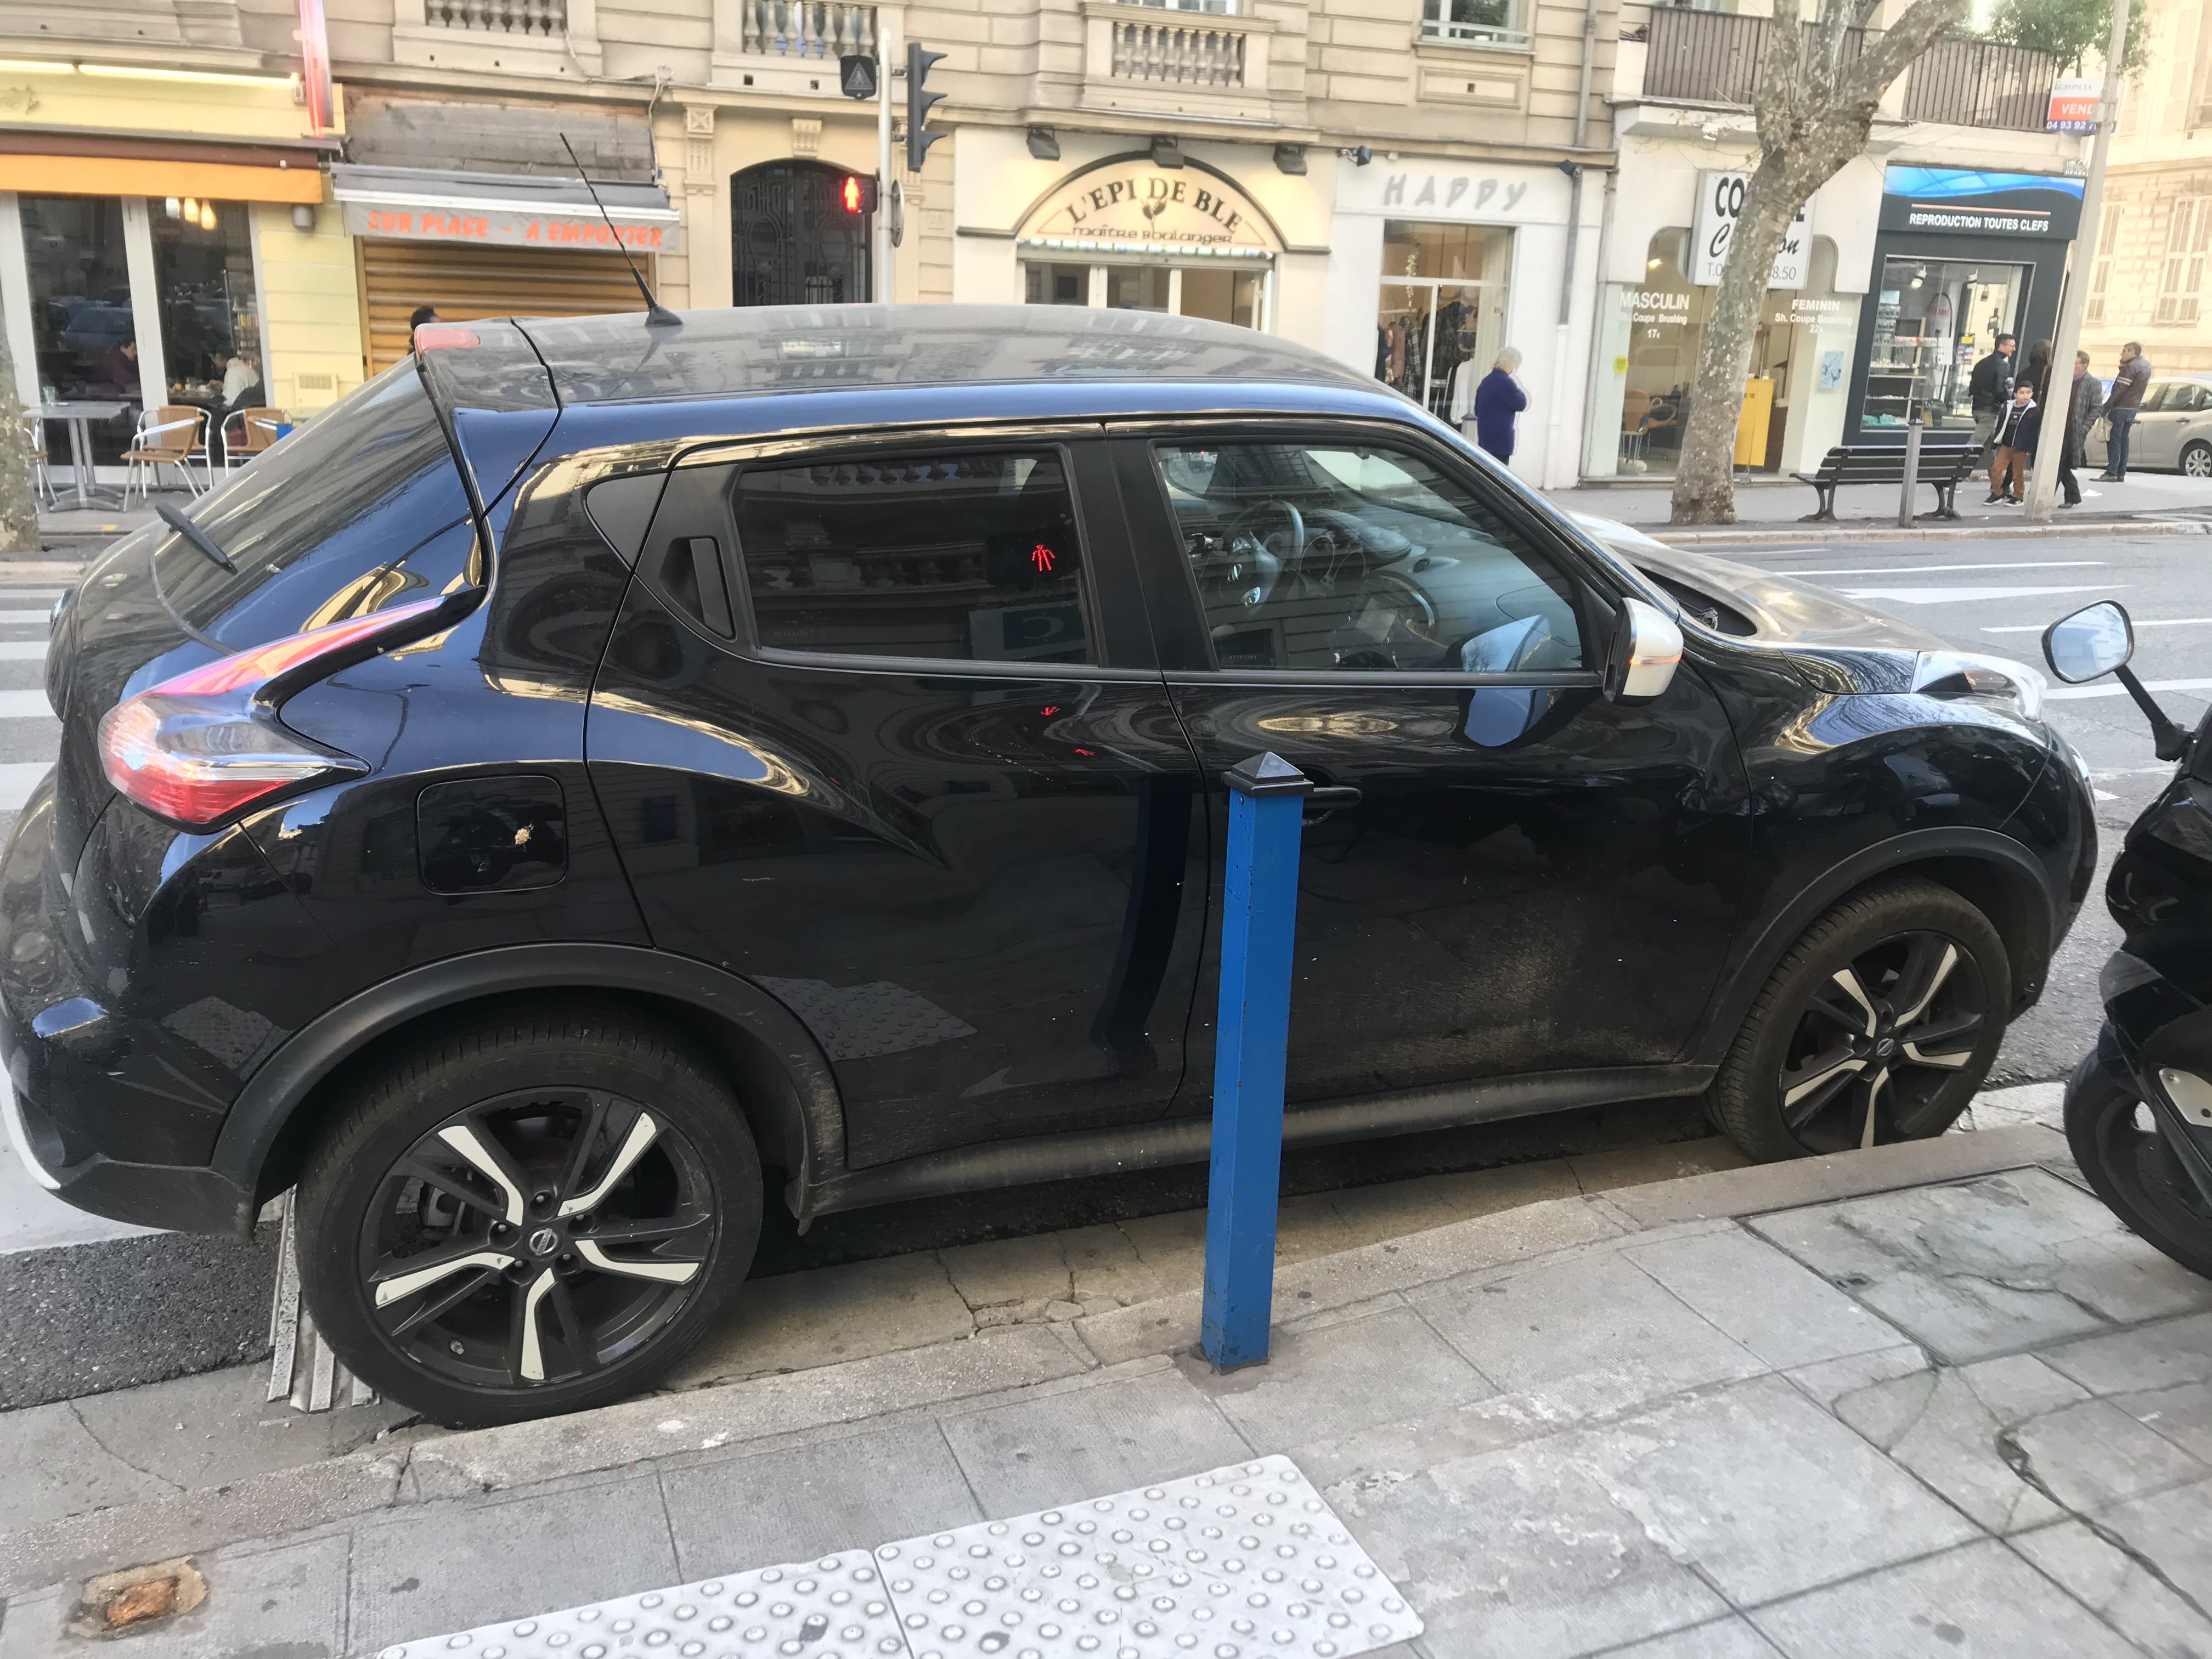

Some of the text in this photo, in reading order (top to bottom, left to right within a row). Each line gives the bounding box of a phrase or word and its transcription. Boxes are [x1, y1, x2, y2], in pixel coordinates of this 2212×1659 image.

[2062, 104, 2093, 114] VEND
[2046, 121, 2058, 129] 04
[2060, 121, 2072, 129] 93
[2074, 121, 2086, 129] 92
[1384, 173, 1527, 211] HAPPY
[1148, 177, 1187, 203] DE
[1194, 187, 1243, 234] BLE
[367, 211, 412, 234] SUR
[421, 213, 489, 238] PLACE
[548, 222, 663, 247] EMPORTER
[1910, 213, 2050, 232] REPRODUCTION TOUTES CLEFS
[1620, 291, 1690, 310] MASCULIN
[1792, 299, 1841, 311] FEMININ
[1633, 312, 1656, 324] Coupe
[1658, 313, 1688, 325] Brushing
[1790, 313, 1816, 324] Coupe
